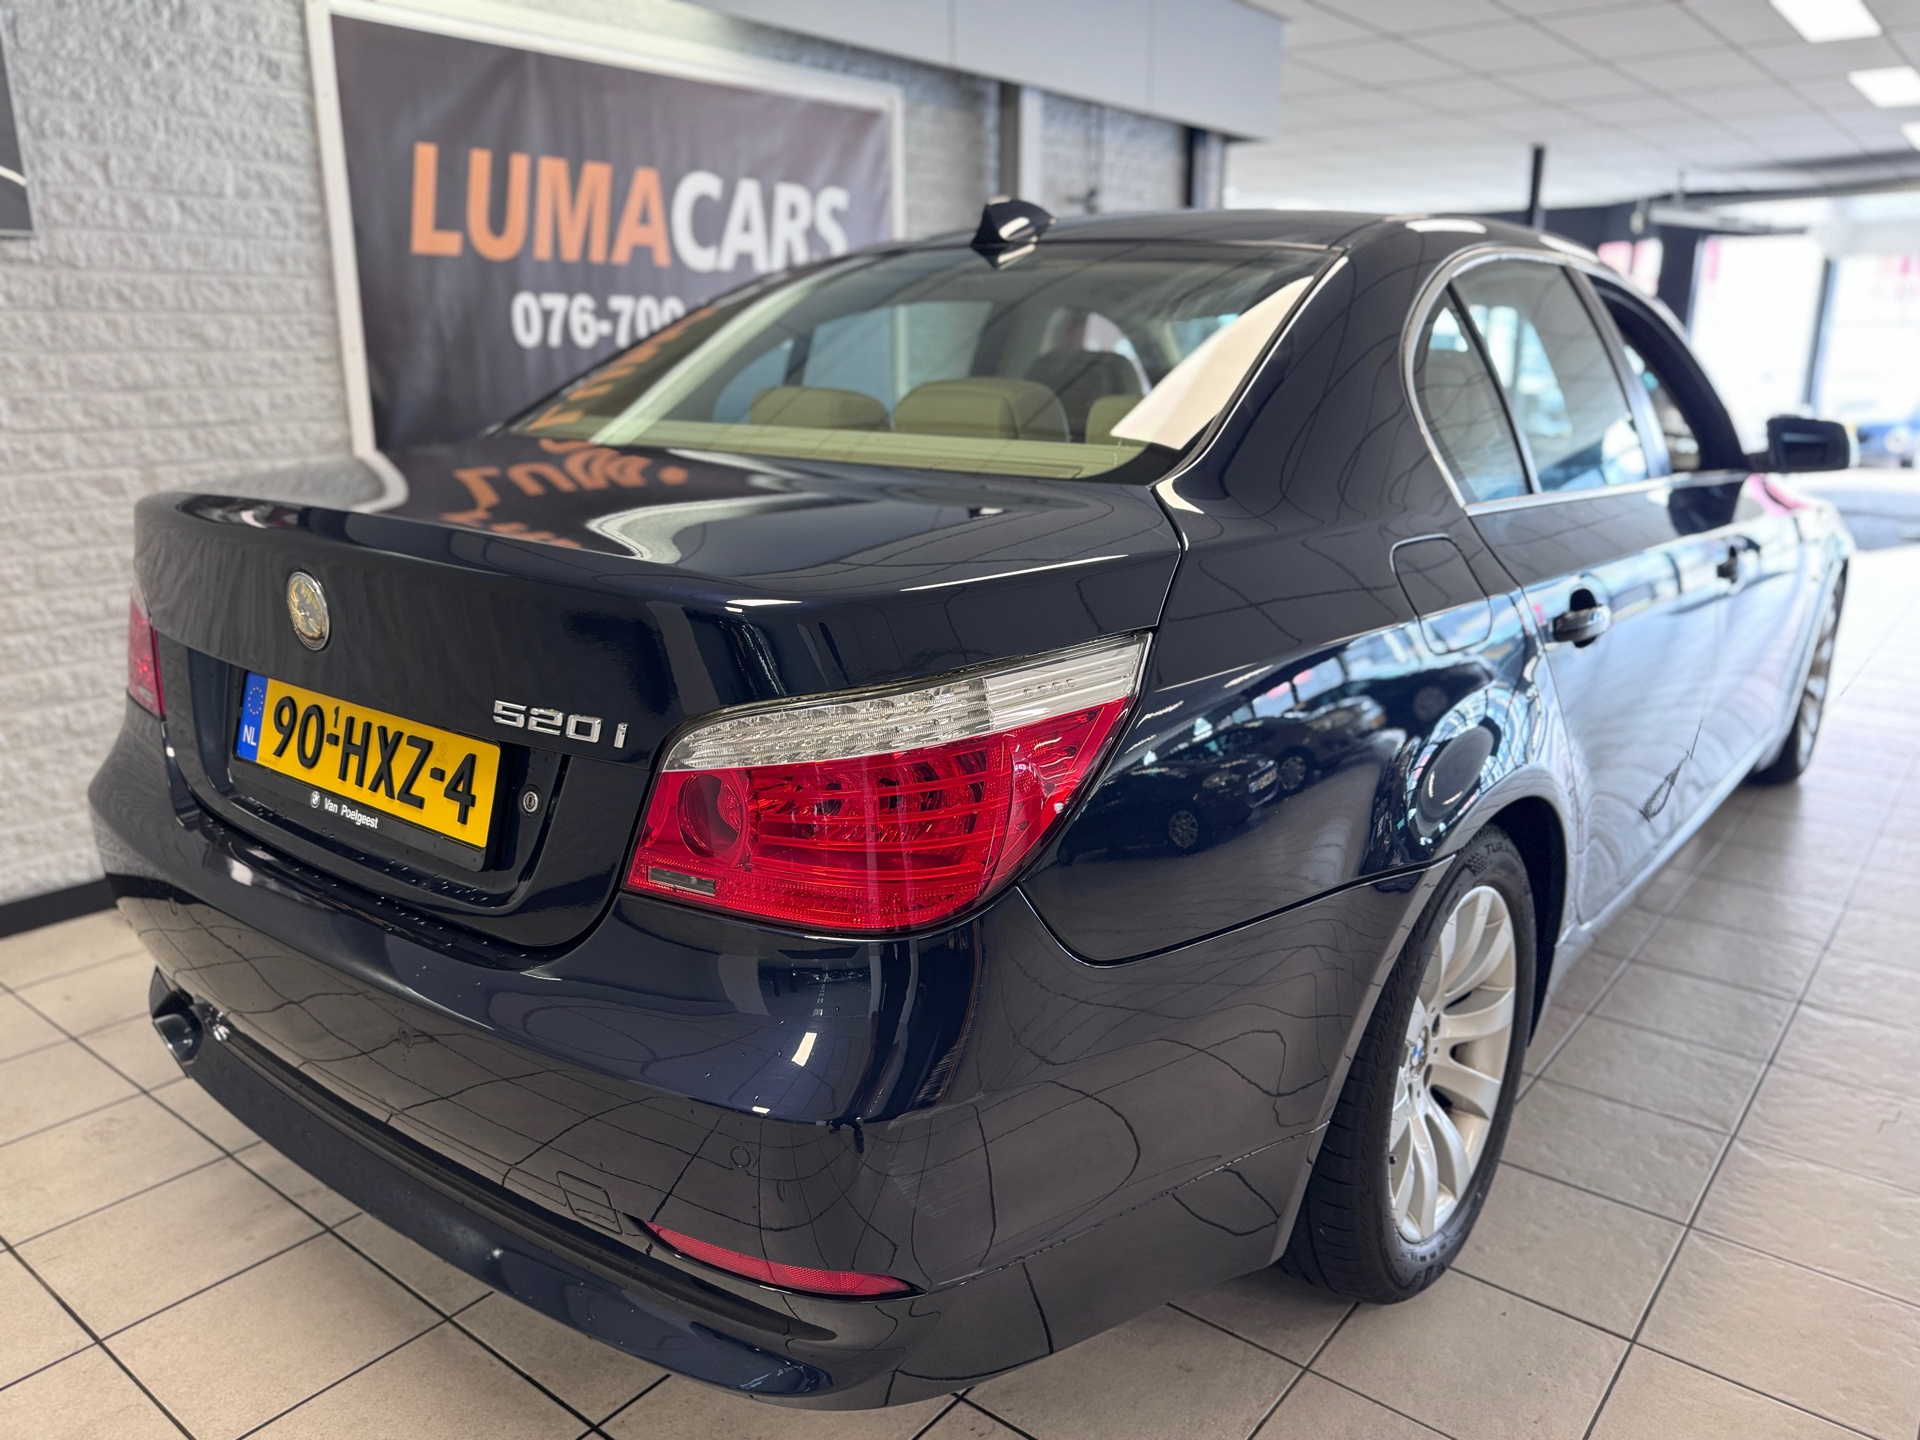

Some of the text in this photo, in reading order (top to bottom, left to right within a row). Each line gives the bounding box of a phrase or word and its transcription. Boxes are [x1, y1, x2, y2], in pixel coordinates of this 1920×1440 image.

[410, 141, 850, 275] LUMACARS
[242, 724, 258, 747] NL
[272, 695, 477, 825] 90-HXZ-4
[324, 797, 379, 829] Van Poelgeest
